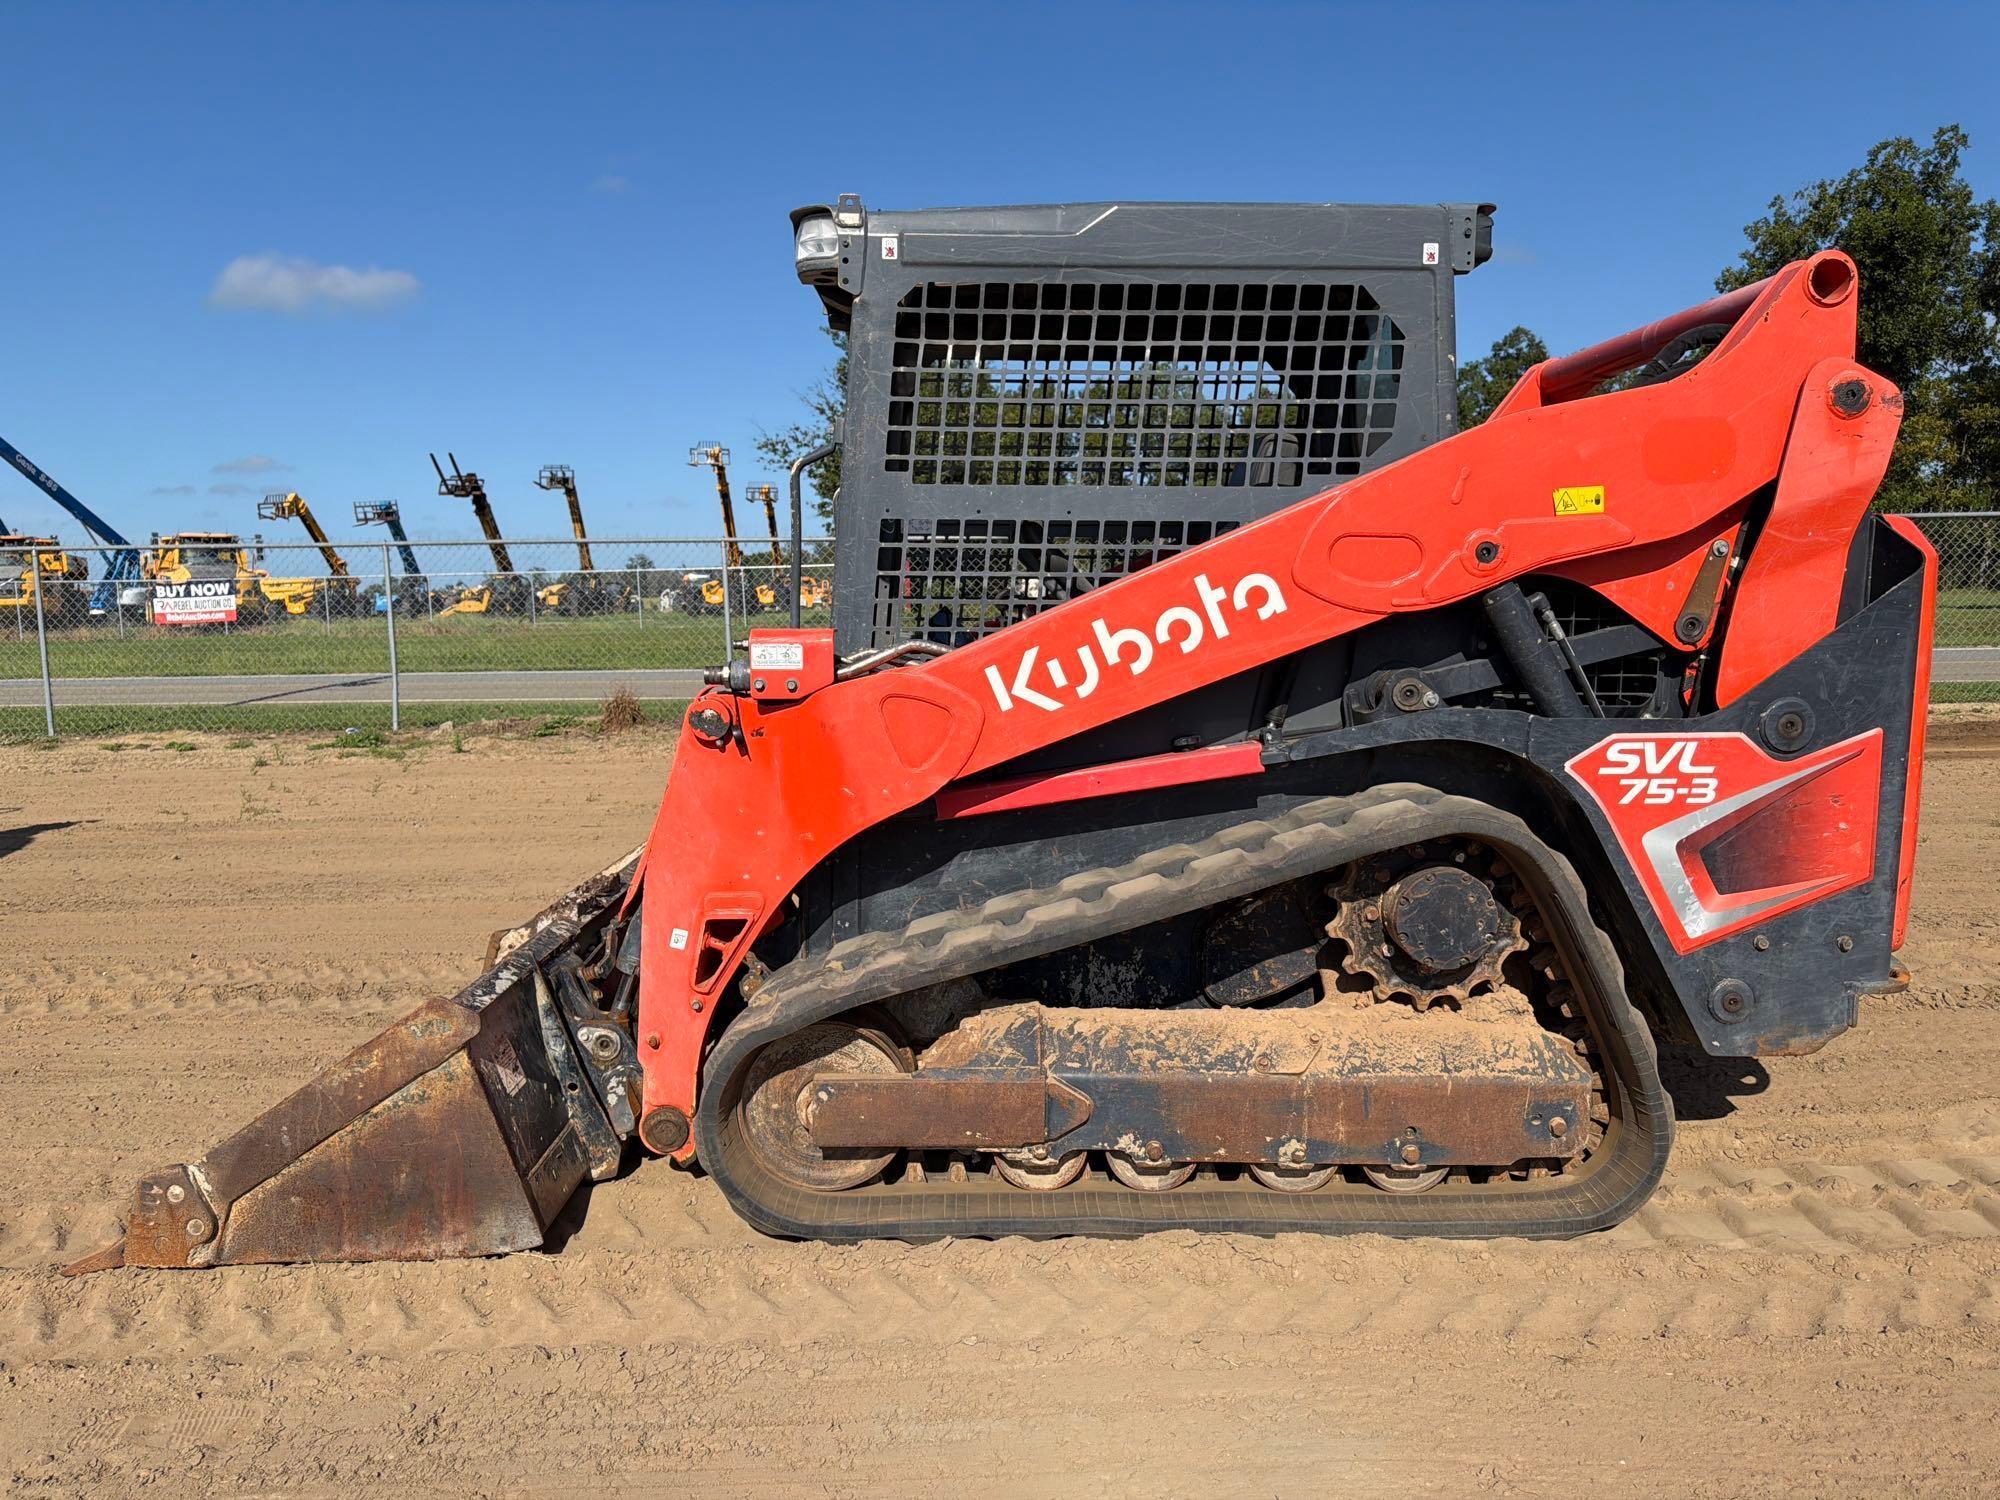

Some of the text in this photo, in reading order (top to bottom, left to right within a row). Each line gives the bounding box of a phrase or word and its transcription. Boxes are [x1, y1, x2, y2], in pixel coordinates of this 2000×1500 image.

[156, 582, 230, 598] BUY NOW
[173, 600, 192, 610] REBEL
[194, 598, 221, 610] AUCTION
[984, 572, 1288, 712] Kubota
[1598, 741, 1716, 775] SVL
[1618, 777, 1718, 805] 75-3
